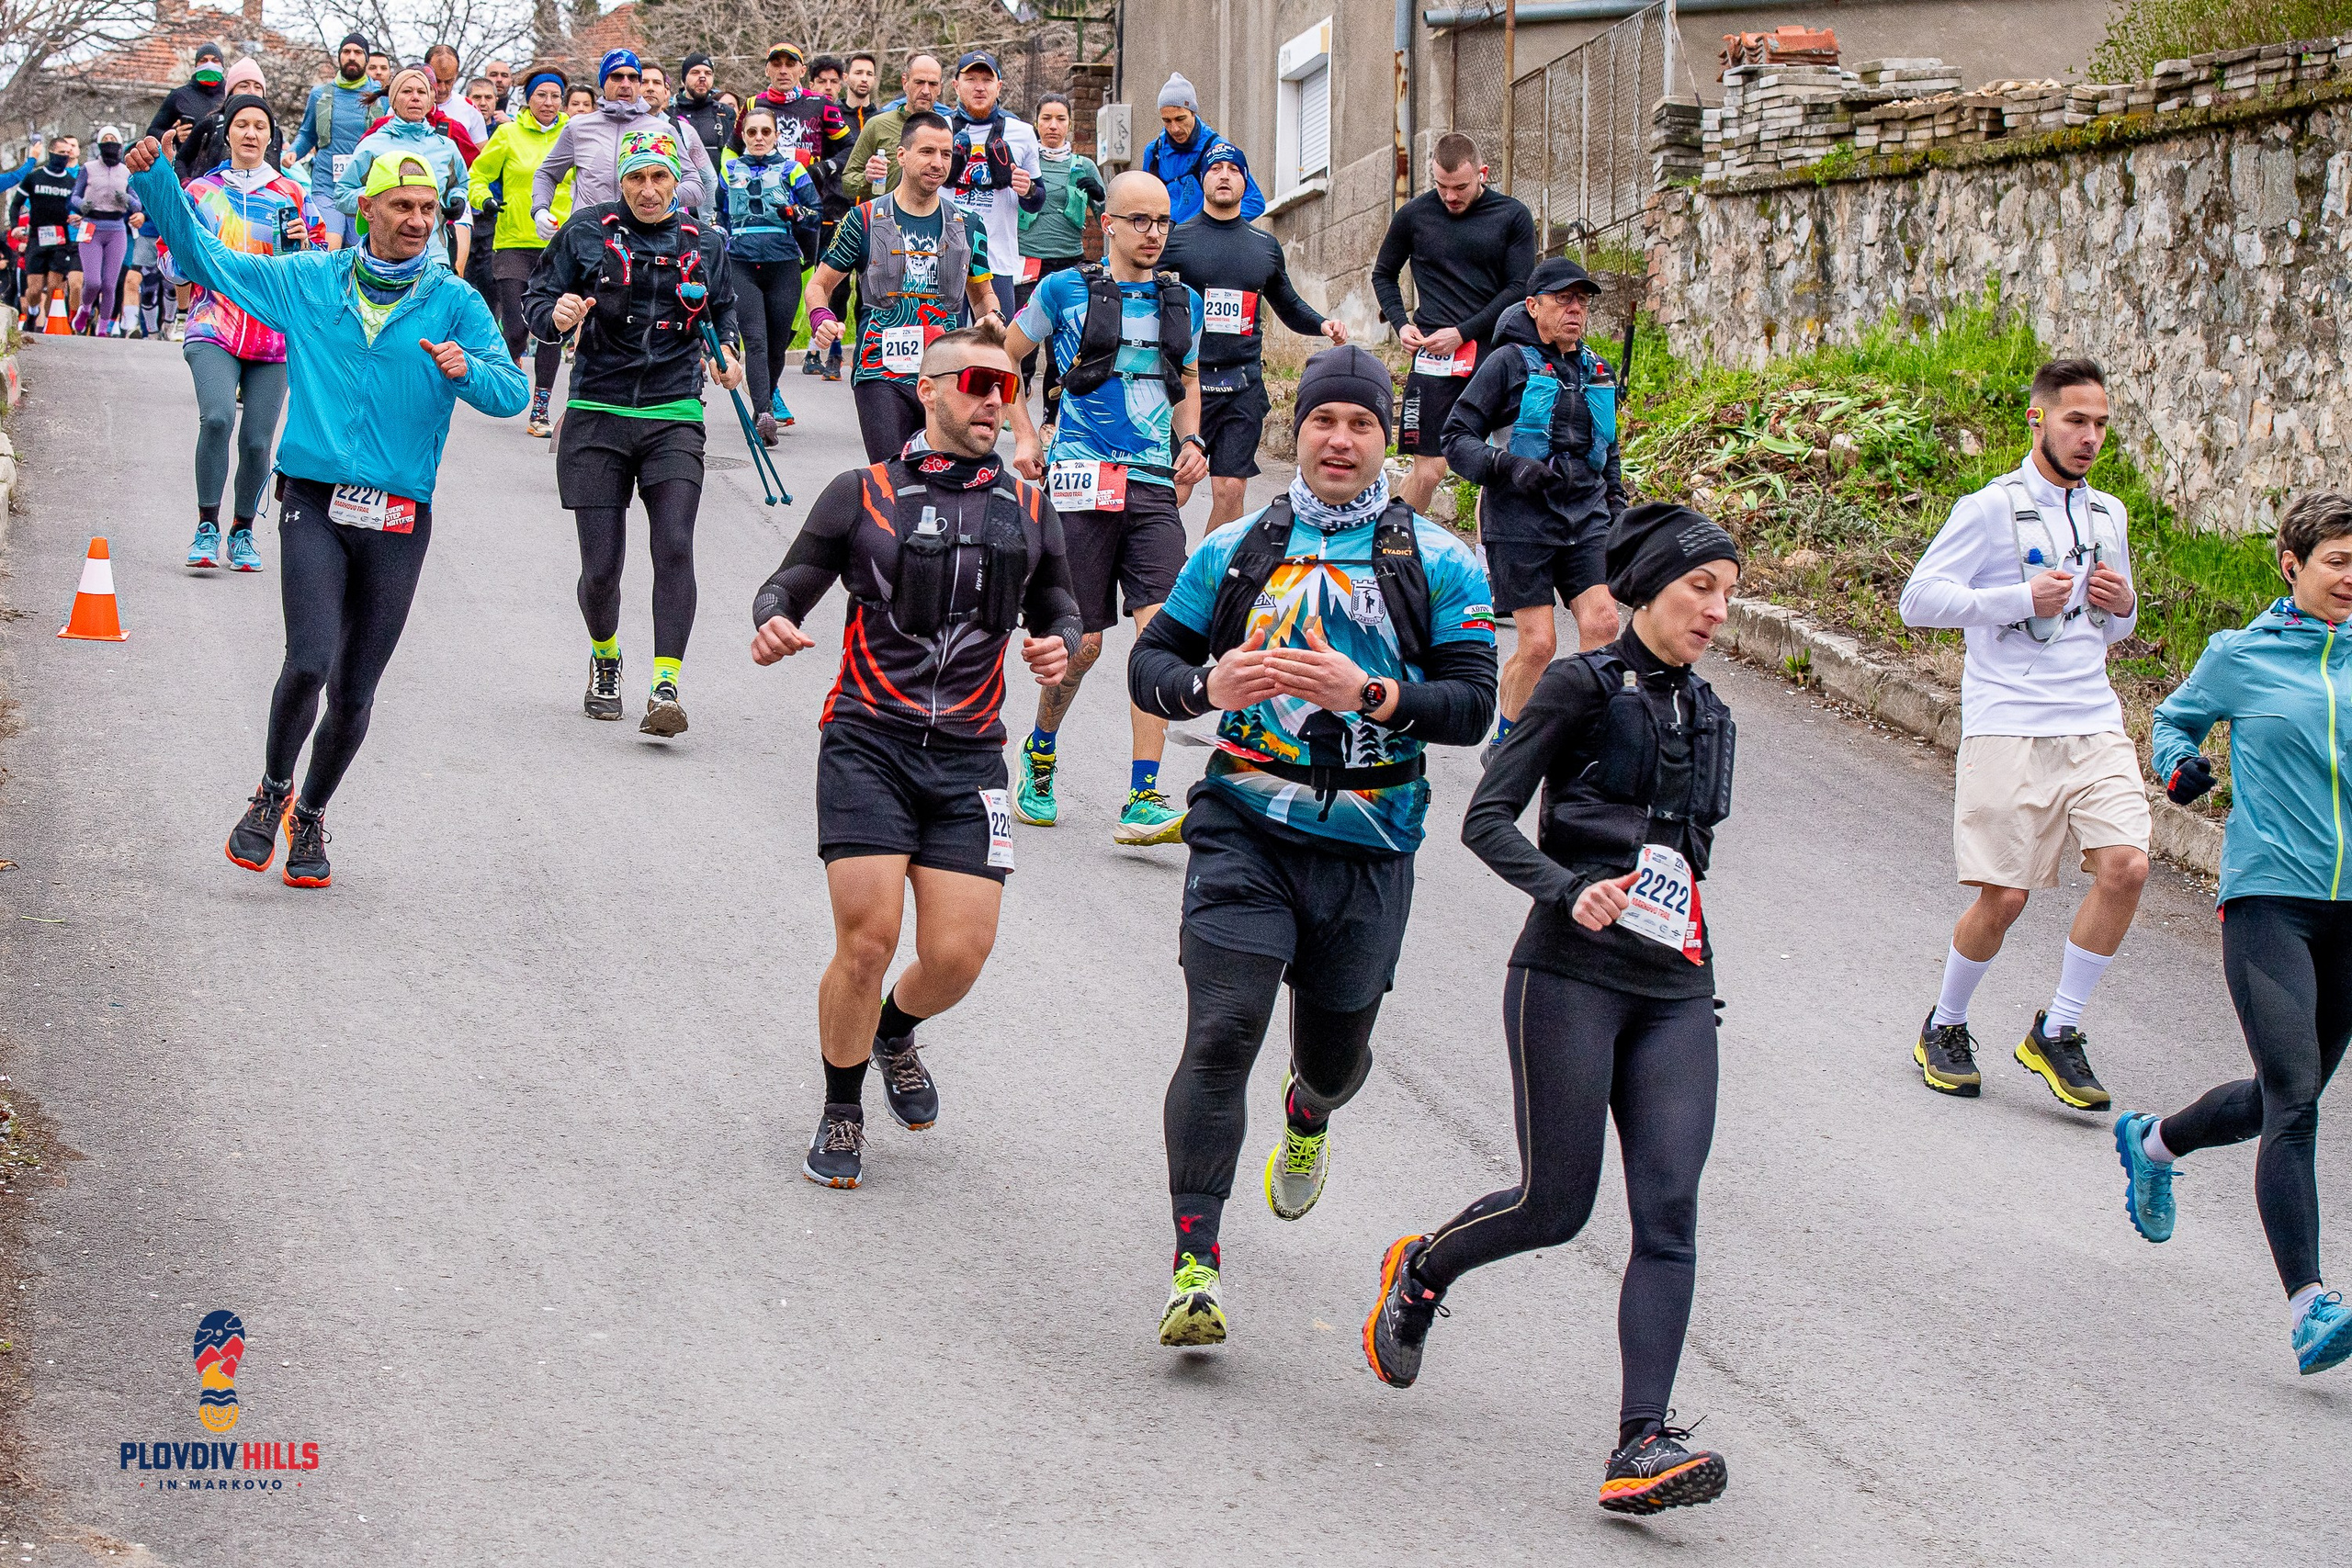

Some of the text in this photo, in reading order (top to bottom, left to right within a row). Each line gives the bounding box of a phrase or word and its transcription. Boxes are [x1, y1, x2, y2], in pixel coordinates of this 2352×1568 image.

[1205, 301, 1239, 317] 2309
[886, 340, 919, 356] 2162
[1053, 472, 1092, 490] 2178
[335, 484, 383, 506] 2227
[334, 499, 369, 513] MARKOVO TRAIL
[386, 512, 401, 522] STEP
[1382, 547, 1412, 556] EVADICT
[1634, 867, 1689, 916] 2222
